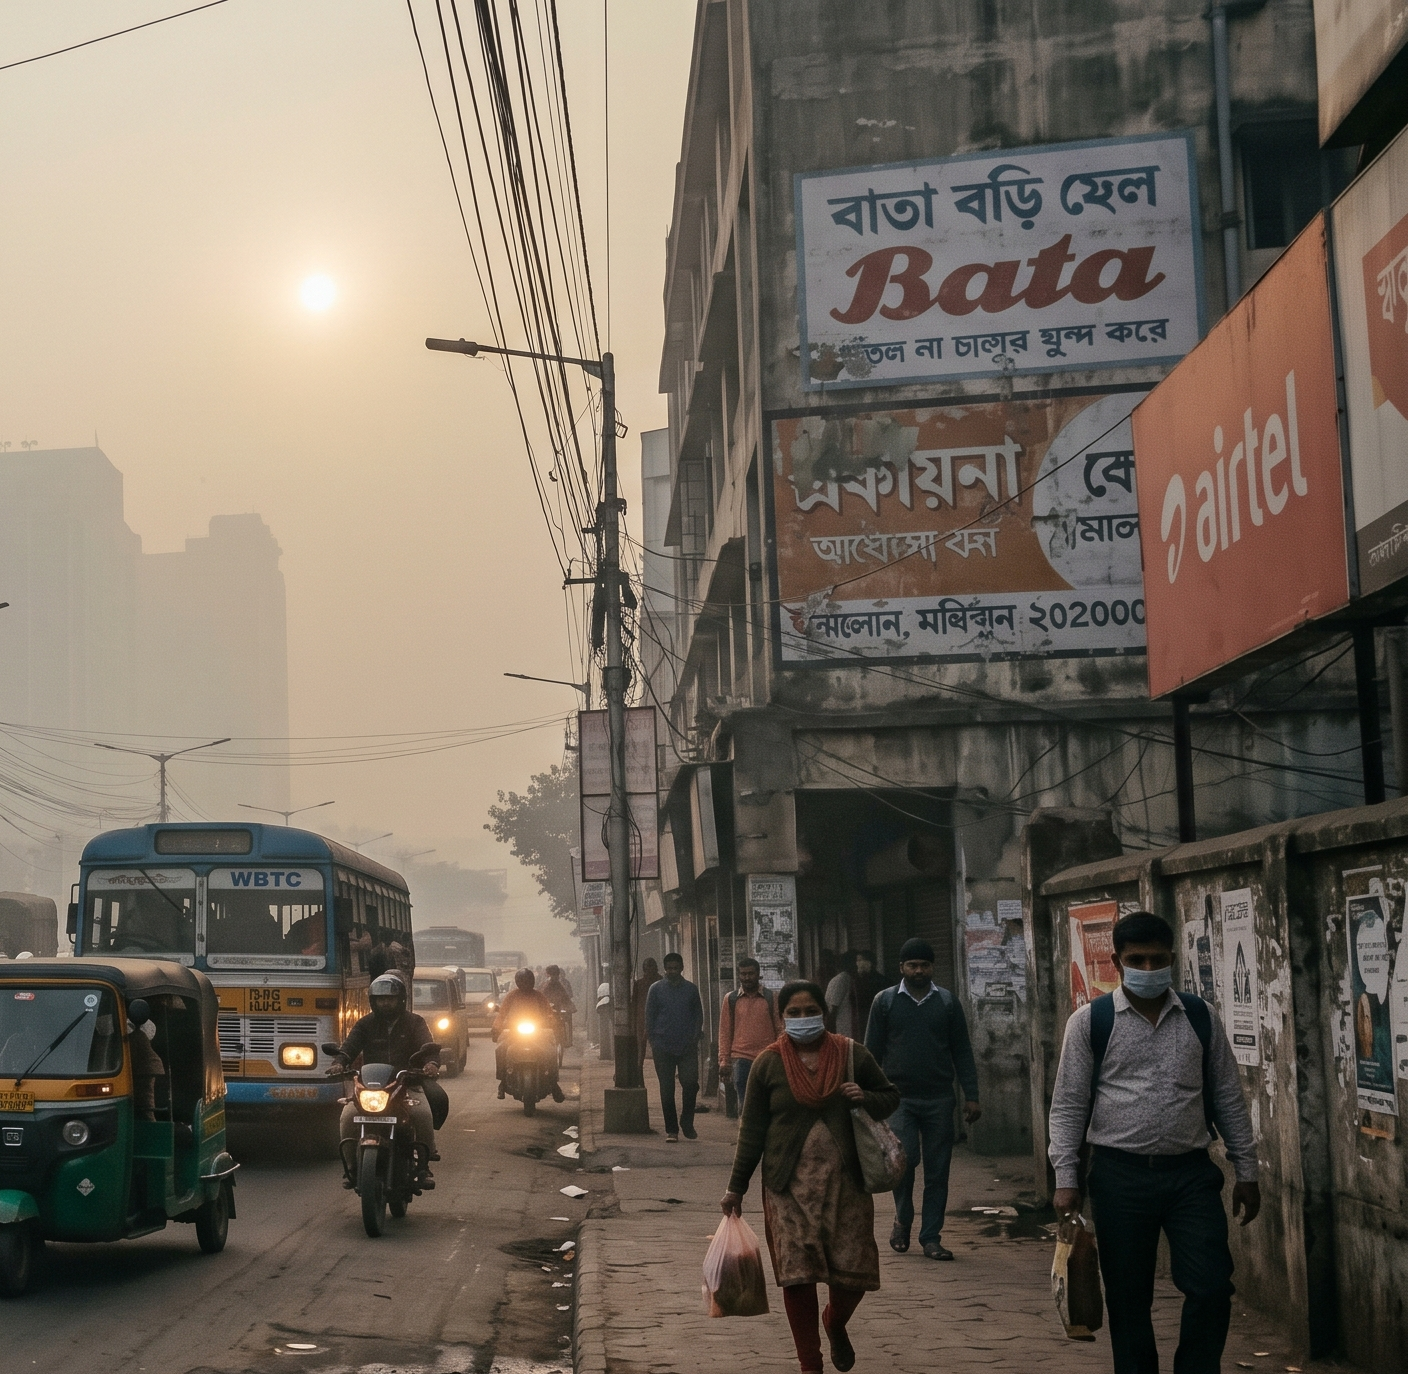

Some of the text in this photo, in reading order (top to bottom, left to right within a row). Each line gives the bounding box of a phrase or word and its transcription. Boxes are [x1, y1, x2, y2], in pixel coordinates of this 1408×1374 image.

[827, 181, 939, 236] বাতা
[950, 164, 1044, 230] বড়ি
[829, 234, 1166, 325] Bata
[915, 337, 944, 359] না
[1105, 318, 1169, 343] করে
[1195, 369, 1308, 563] airtel
[230, 871, 302, 887] WBTC
